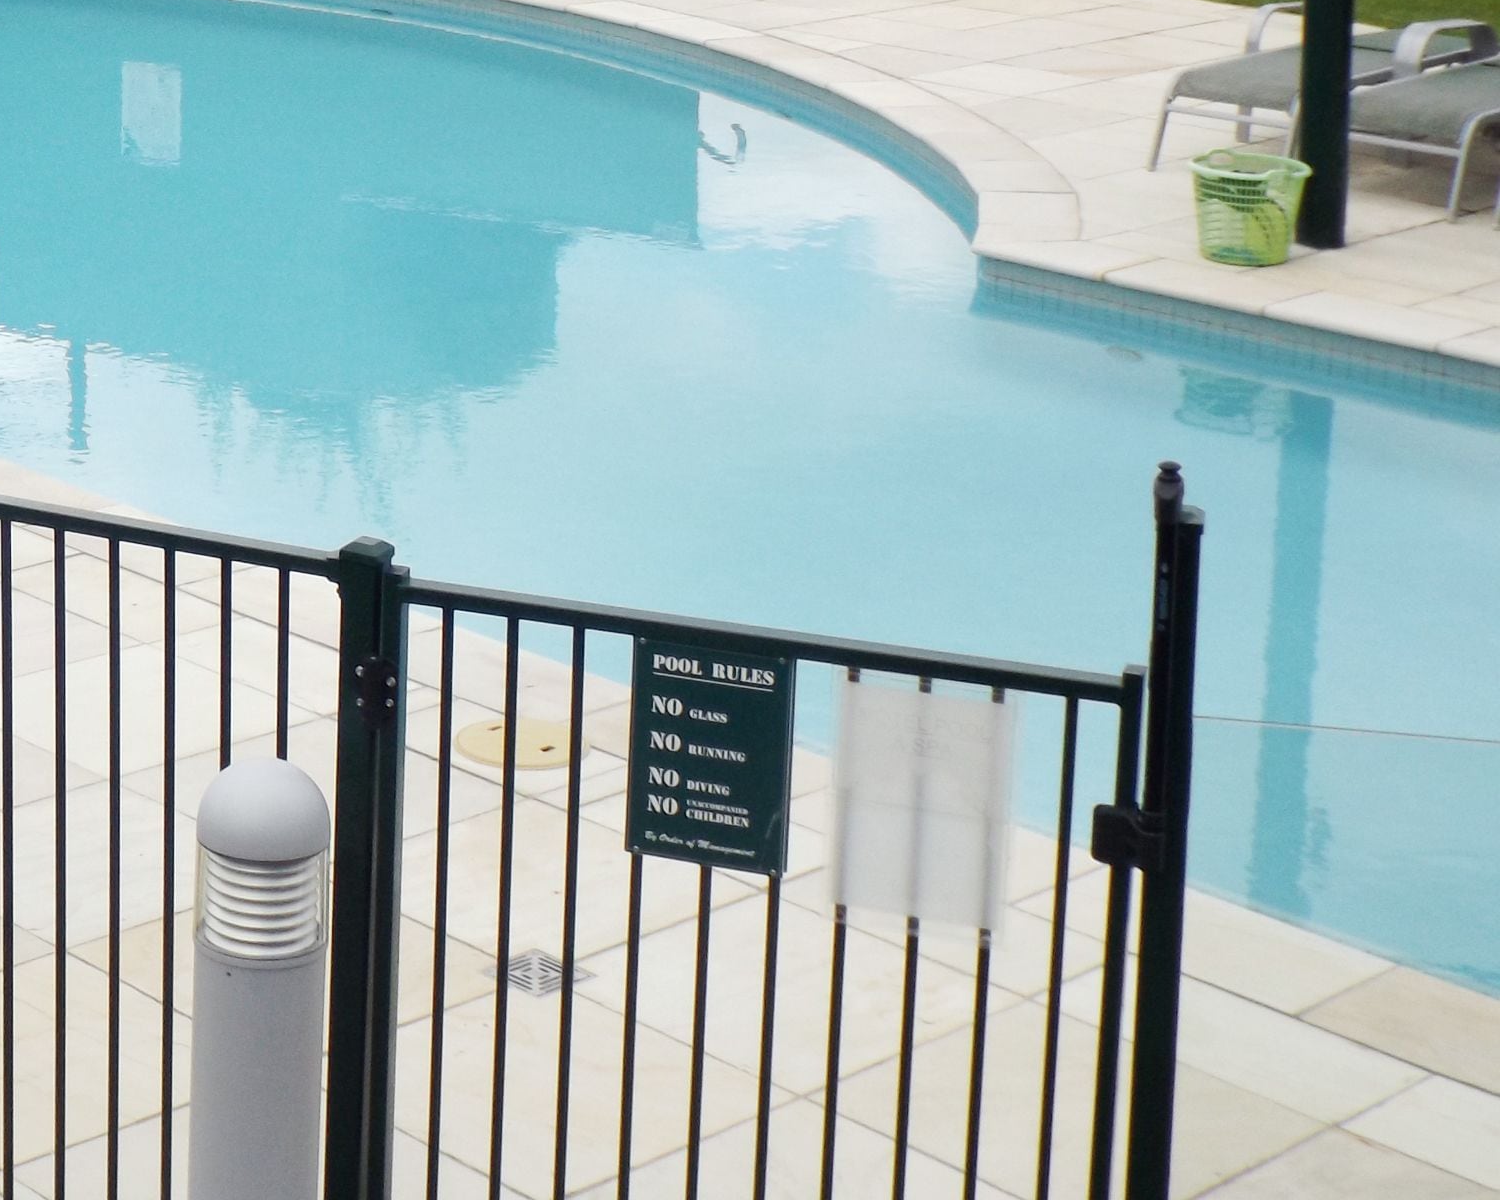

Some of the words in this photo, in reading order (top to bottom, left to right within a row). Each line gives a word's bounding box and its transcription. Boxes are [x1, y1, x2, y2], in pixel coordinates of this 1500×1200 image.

[652, 653, 703, 676] POOL
[711, 662, 775, 686] RULES
[651, 694, 683, 716] NO
[689, 708, 728, 724] GLASS
[649, 730, 681, 752] NO
[688, 743, 746, 763] RUNNING
[648, 766, 680, 788] NO
[686, 779, 730, 796] DIVING
[647, 794, 679, 816] NO
[686, 799, 749, 815] UNACCOMPANIED
[685, 808, 750, 829] CHILDREN
[644, 830, 657, 842] By
[659, 833, 684, 845] Order
[685, 839, 696, 849] of
[697, 839, 756, 857] Management
